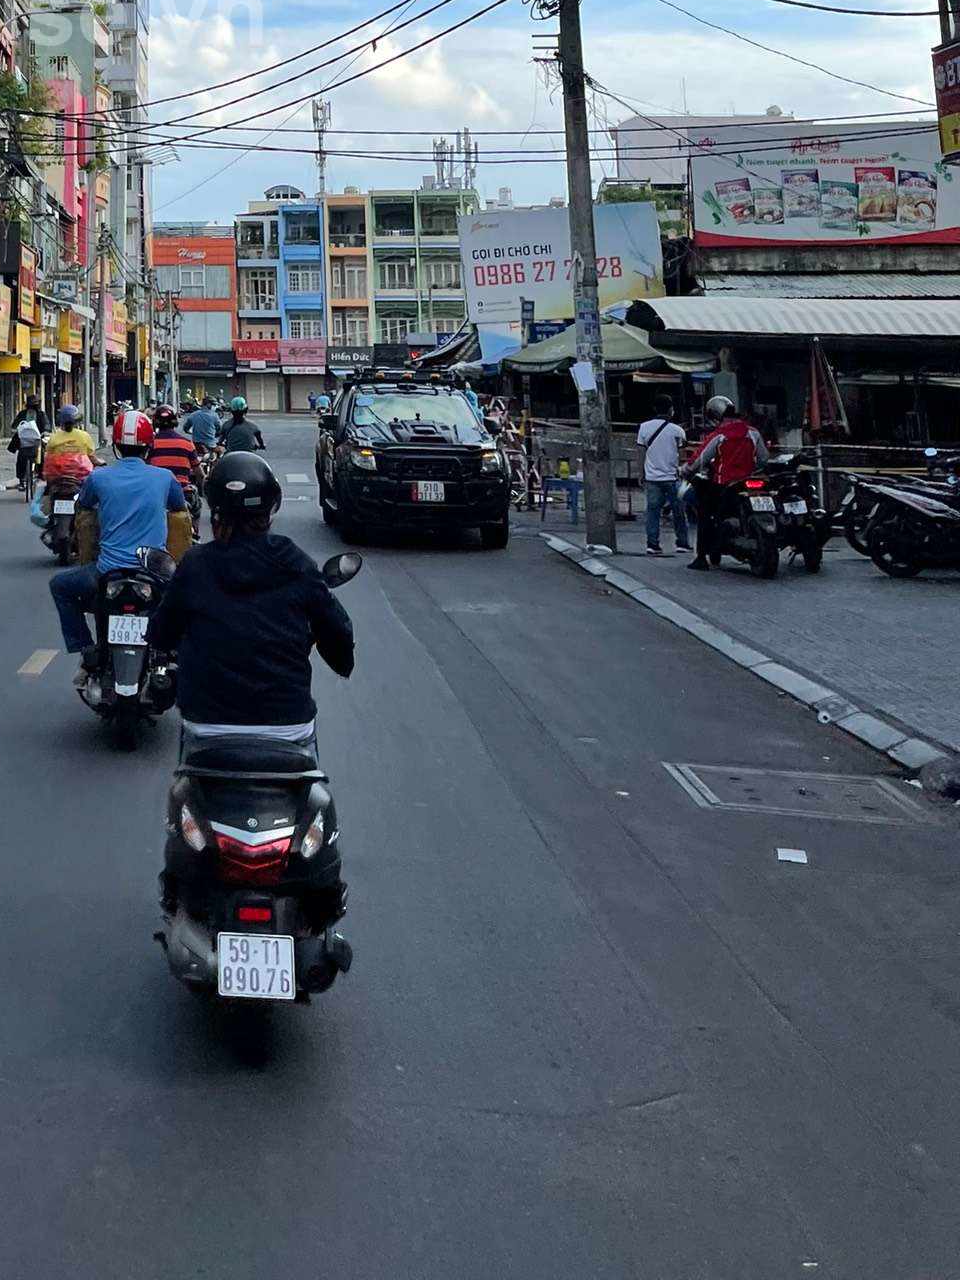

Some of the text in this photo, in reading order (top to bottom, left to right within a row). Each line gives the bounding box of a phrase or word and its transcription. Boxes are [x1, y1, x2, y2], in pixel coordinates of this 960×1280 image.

[494, 247, 505, 258] ĐI
[533, 243, 552, 255] CHI
[474, 263, 525, 287] 0986
[532, 260, 556, 283] 27
[596, 256, 623, 279] 28
[229, 937, 280, 965] 59-T1
[223, 966, 290, 994] 890.76
